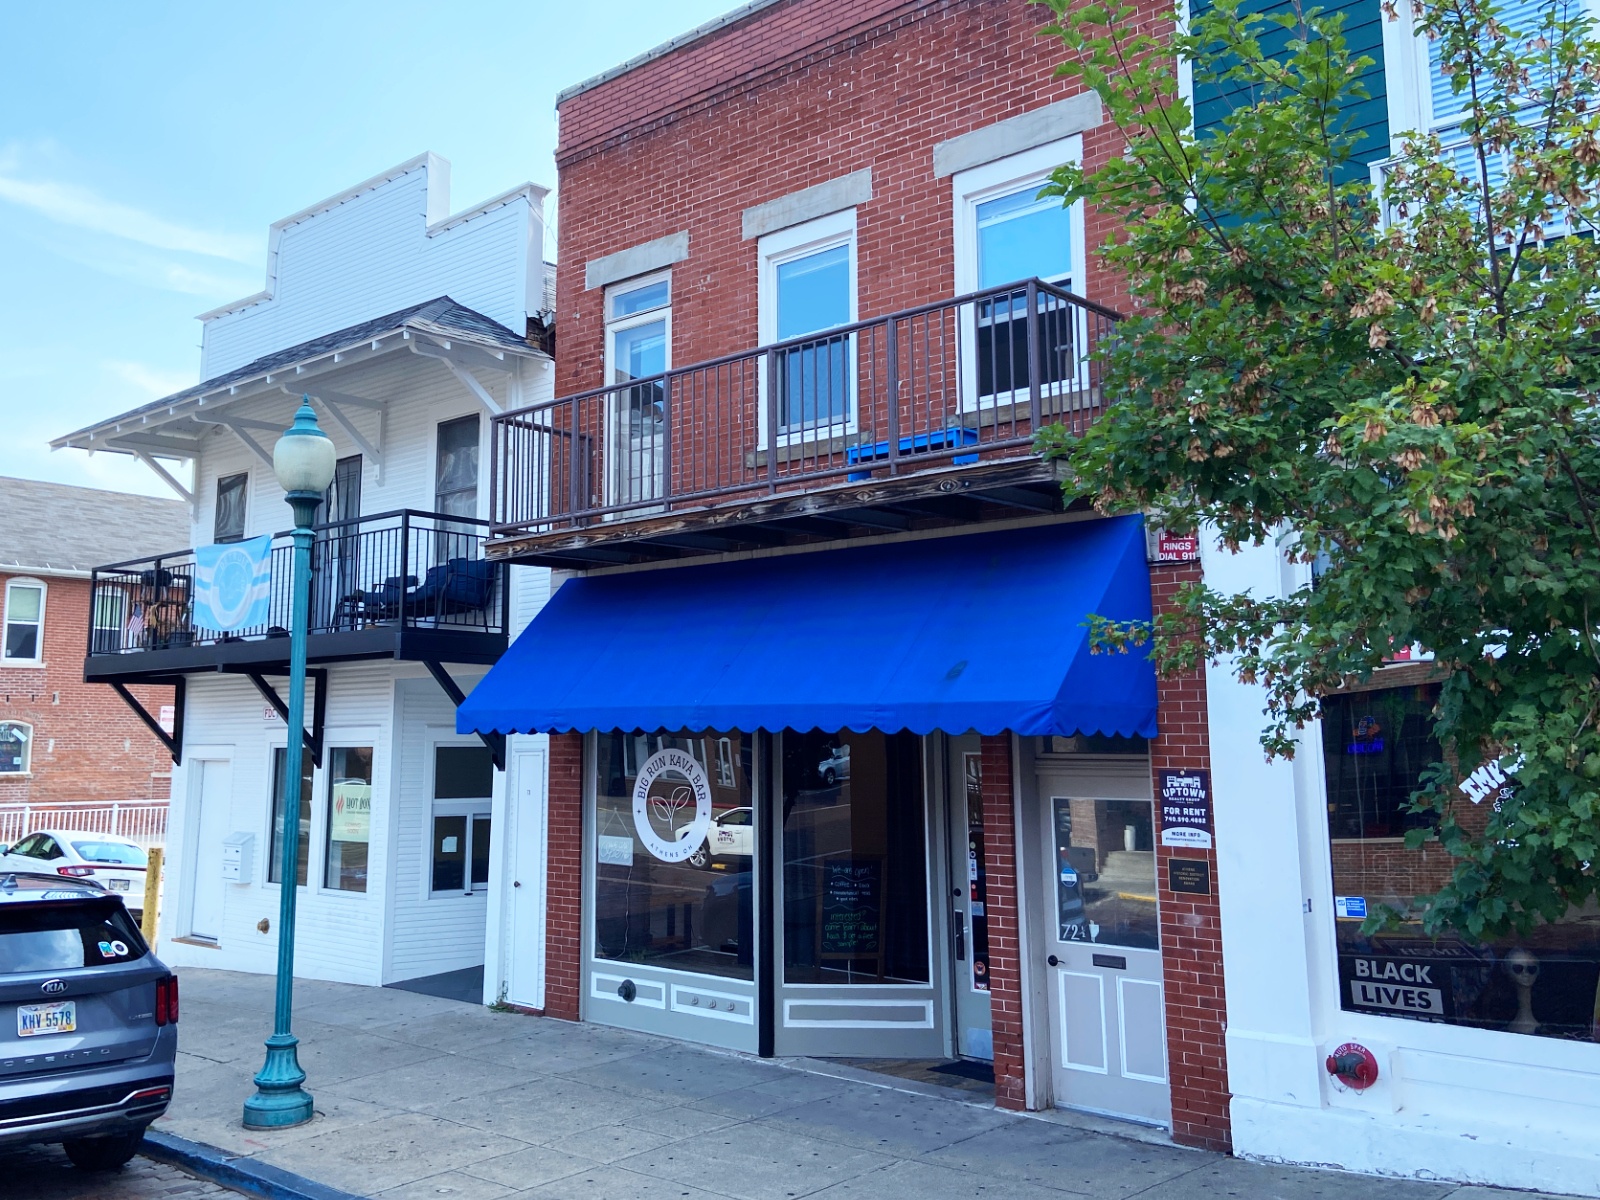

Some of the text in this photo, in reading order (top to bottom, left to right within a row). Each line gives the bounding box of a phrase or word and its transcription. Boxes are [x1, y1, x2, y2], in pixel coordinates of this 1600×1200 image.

[1160, 532, 1168, 541] IF
[1163, 542, 1192, 551] RINGS
[1159, 552, 1196, 561] DIAL 911
[637, 754, 707, 801] BIG RUN KAVA BAR
[1162, 787, 1206, 799] UPTOWN
[346, 797, 359, 810] HOT
[1163, 806, 1206, 816] FOR RENT
[650, 843, 694, 858] ATHENS OH
[1355, 959, 1433, 984] BLACK
[46, 983, 65, 992] KIA
[1361, 985, 1432, 1009] LIVES
[22, 1010, 72, 1030] KHV 5578
[1334, 1044, 1348, 1058] AUTO
